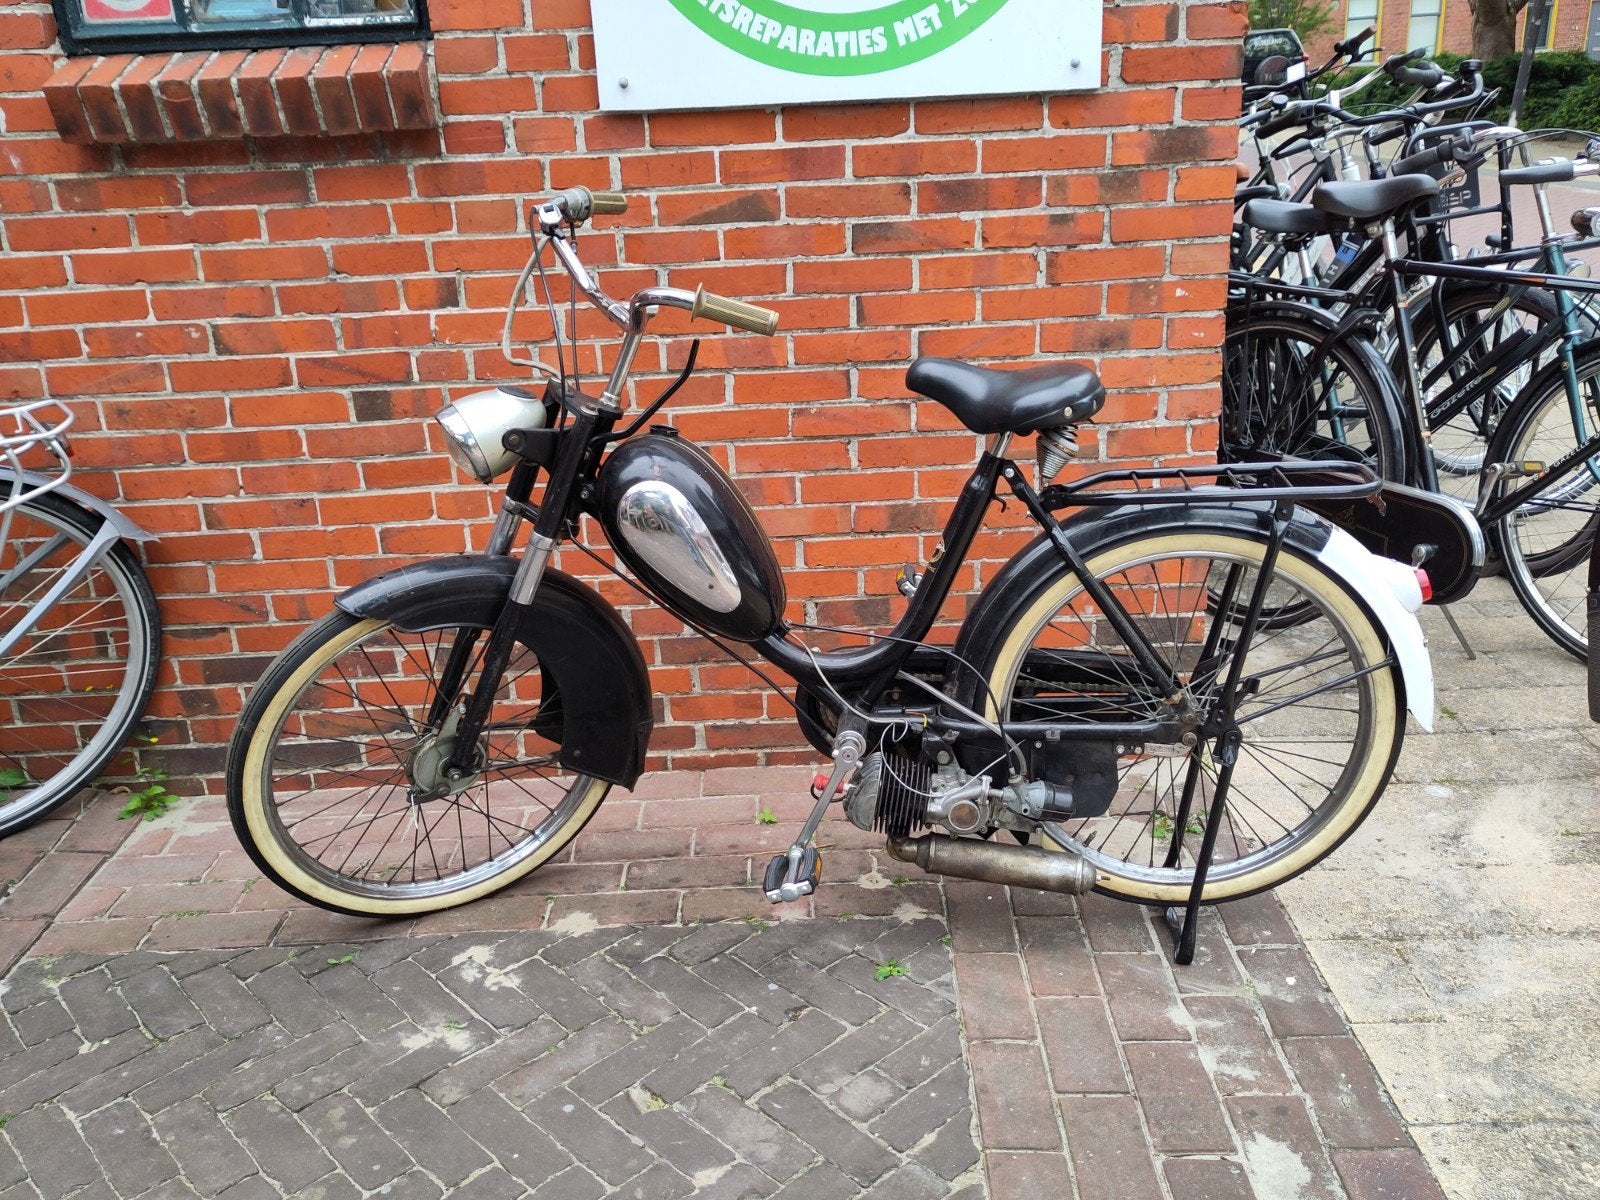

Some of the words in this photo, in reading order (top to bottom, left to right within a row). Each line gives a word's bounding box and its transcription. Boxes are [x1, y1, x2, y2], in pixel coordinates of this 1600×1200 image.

[697, 0, 888, 57] TSREPARATIES
[893, 3, 943, 47] MET
[1554, 438, 1590, 467] GAZELLE
